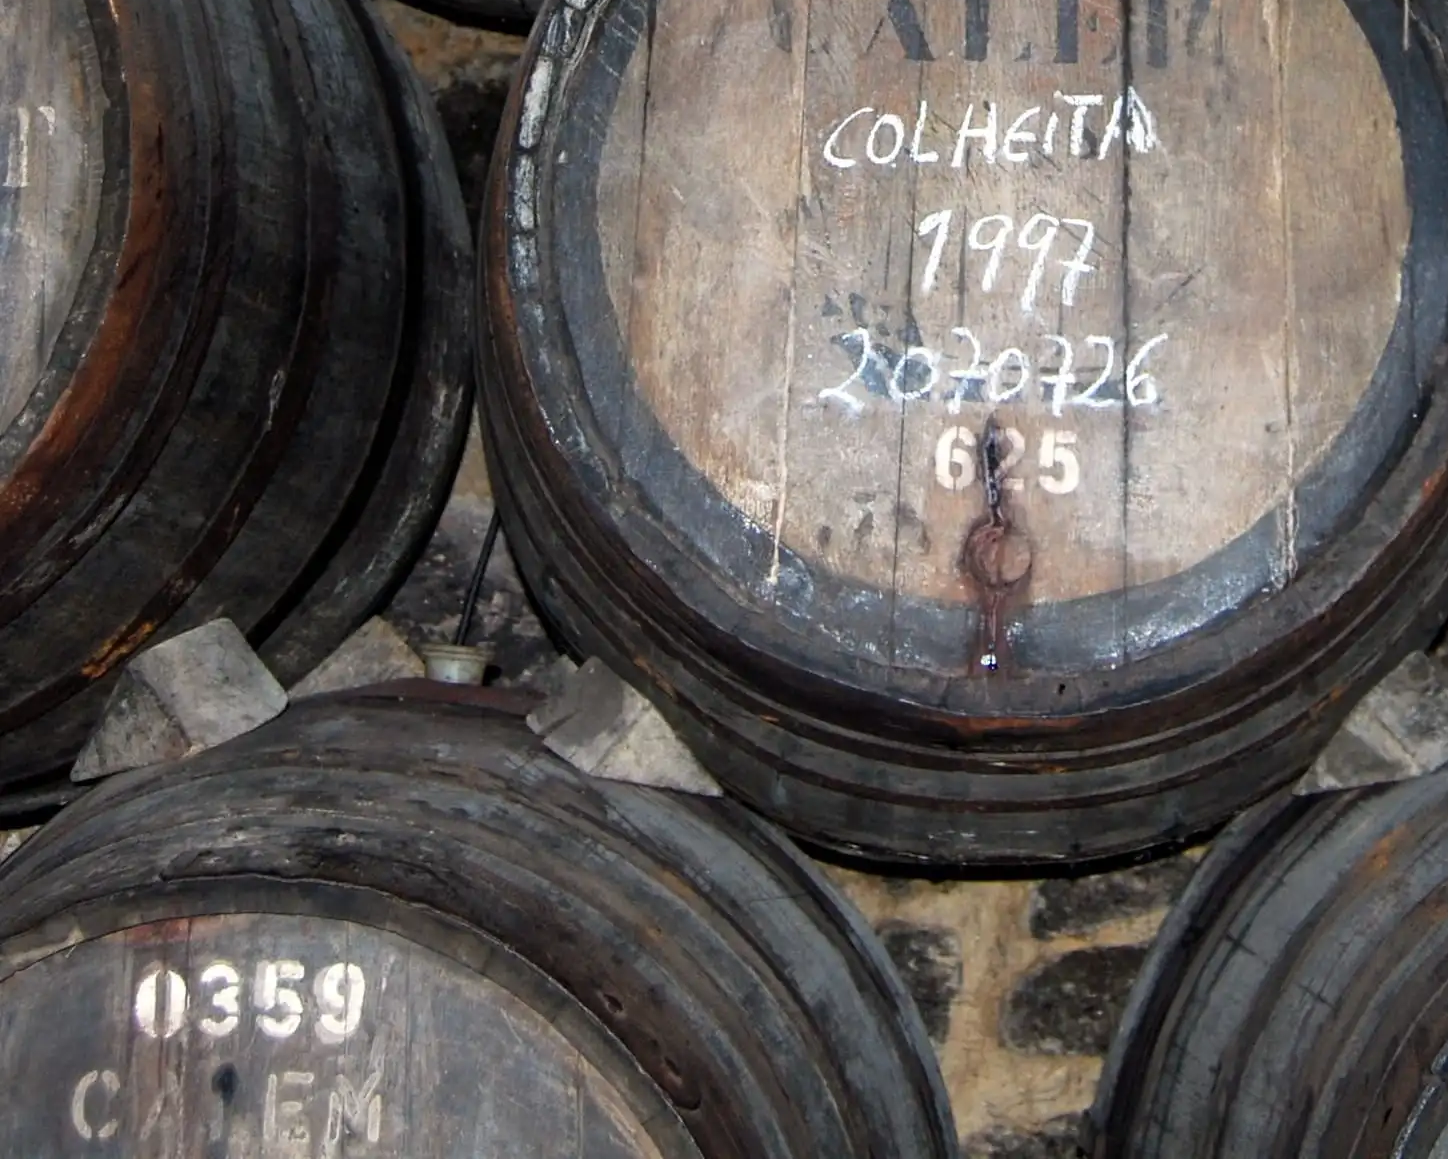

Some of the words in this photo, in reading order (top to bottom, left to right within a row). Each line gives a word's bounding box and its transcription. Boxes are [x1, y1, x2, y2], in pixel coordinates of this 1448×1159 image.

[822, 86, 1160, 168] COLHEITA
[913, 209, 1096, 314] 1997
[133, 960, 365, 1039] 0359
